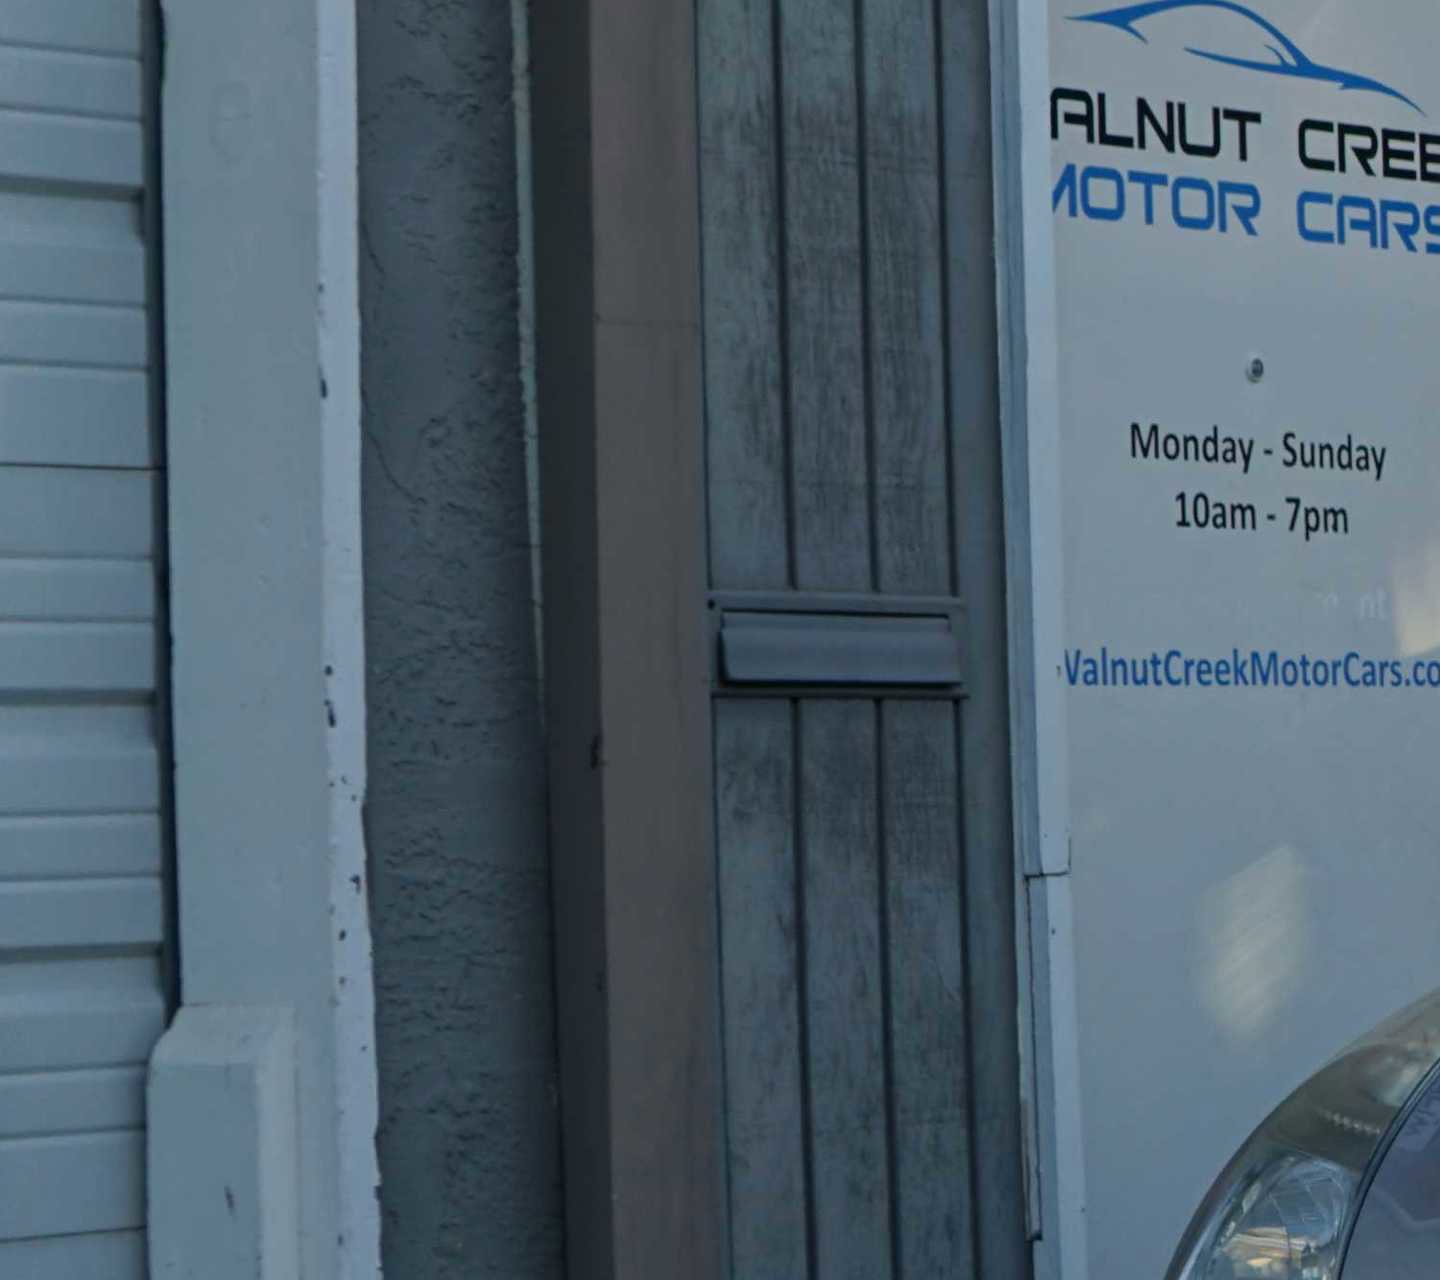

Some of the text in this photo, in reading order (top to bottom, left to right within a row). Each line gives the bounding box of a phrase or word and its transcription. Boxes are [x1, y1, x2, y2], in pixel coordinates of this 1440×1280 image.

[1049, 86, 1262, 163] ALNUT
[1129, 421, 1254, 475] Monday
[1282, 431, 1387, 482] Sunday
[1174, 490, 1257, 531] 10am
[1284, 496, 1349, 542] 7pm
